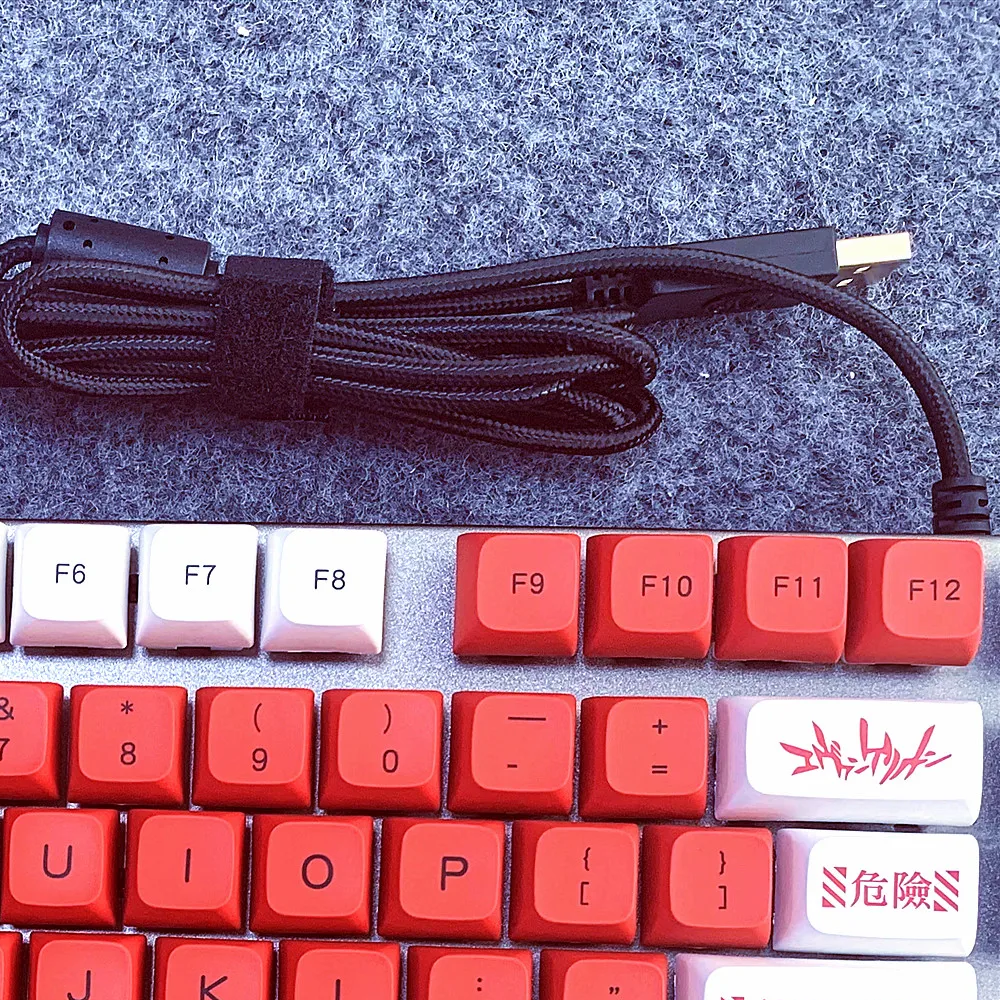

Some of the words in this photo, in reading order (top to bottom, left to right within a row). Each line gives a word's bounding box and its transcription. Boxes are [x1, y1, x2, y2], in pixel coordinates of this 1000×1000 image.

[55, 563, 86, 585] F6
[185, 564, 217, 586] F7
[314, 568, 346, 591] F8
[512, 572, 545, 595] F9
[641, 574, 693, 598] F10
[774, 575, 821, 599] F11
[909, 578, 961, 601] F12
[120, 741, 137, 766] 8
[252, 747, 268, 772] 9
[382, 749, 399, 774] 0
[42, 843, 73, 879] U
[184, 847, 192, 883] I
[301, 853, 334, 890] O
[440, 855, 469, 891] P
[850, 869, 932, 910] 危險
